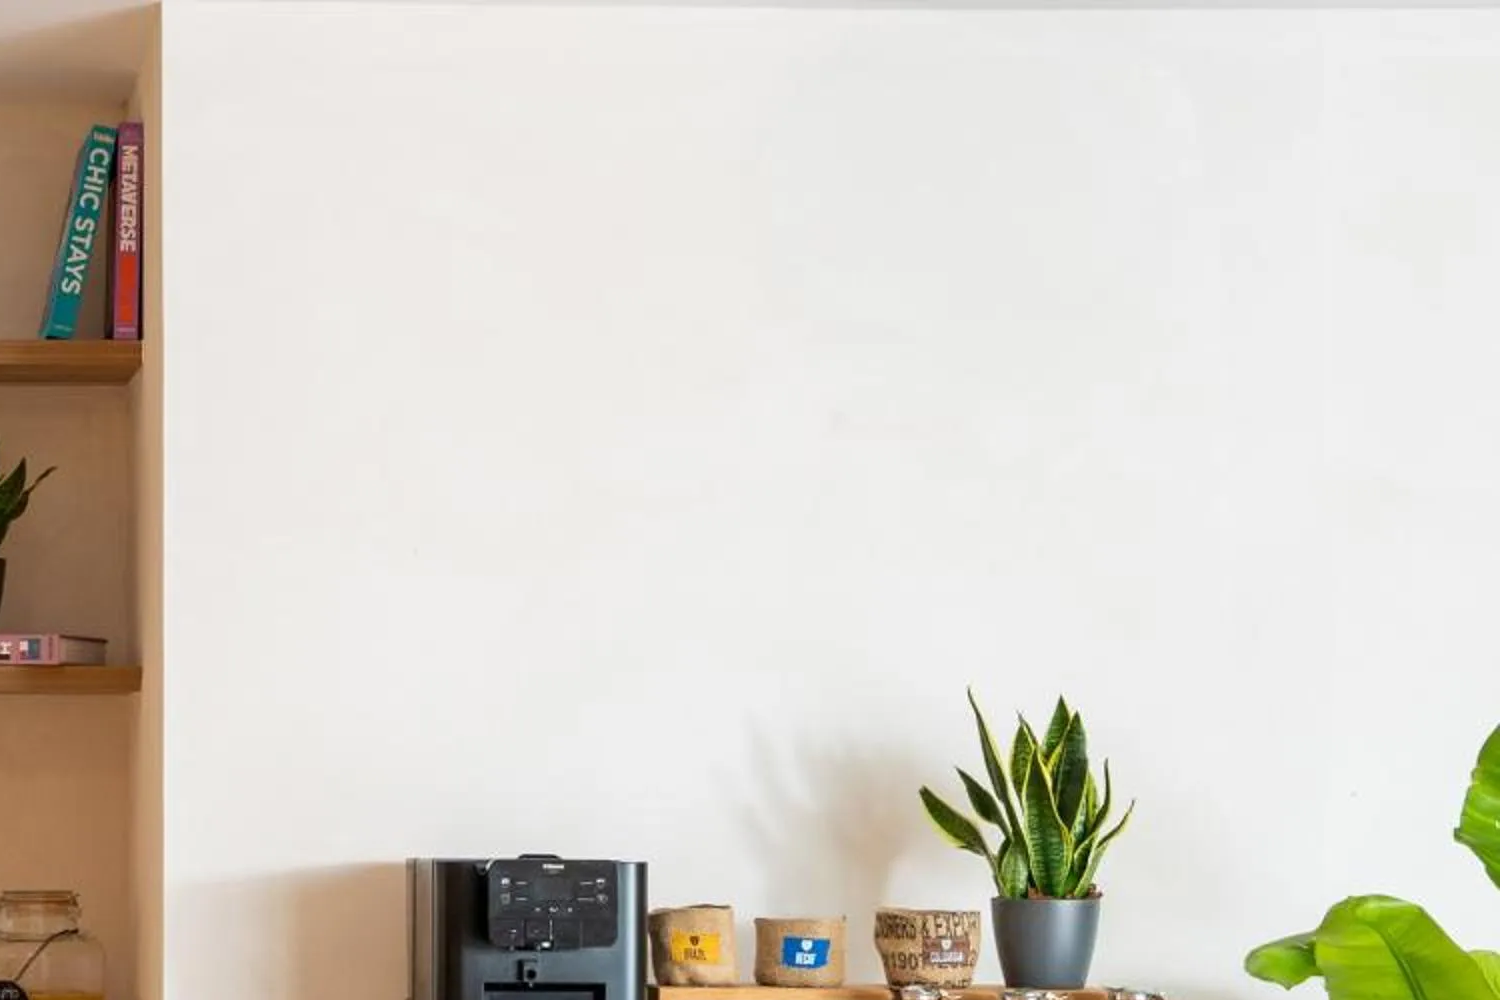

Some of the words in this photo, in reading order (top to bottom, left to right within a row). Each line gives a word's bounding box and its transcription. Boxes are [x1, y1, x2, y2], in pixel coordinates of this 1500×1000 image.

[80, 148, 109, 211] CHIC
[120, 145, 139, 252] METAVERSE
[61, 217, 95, 295] STAYS
